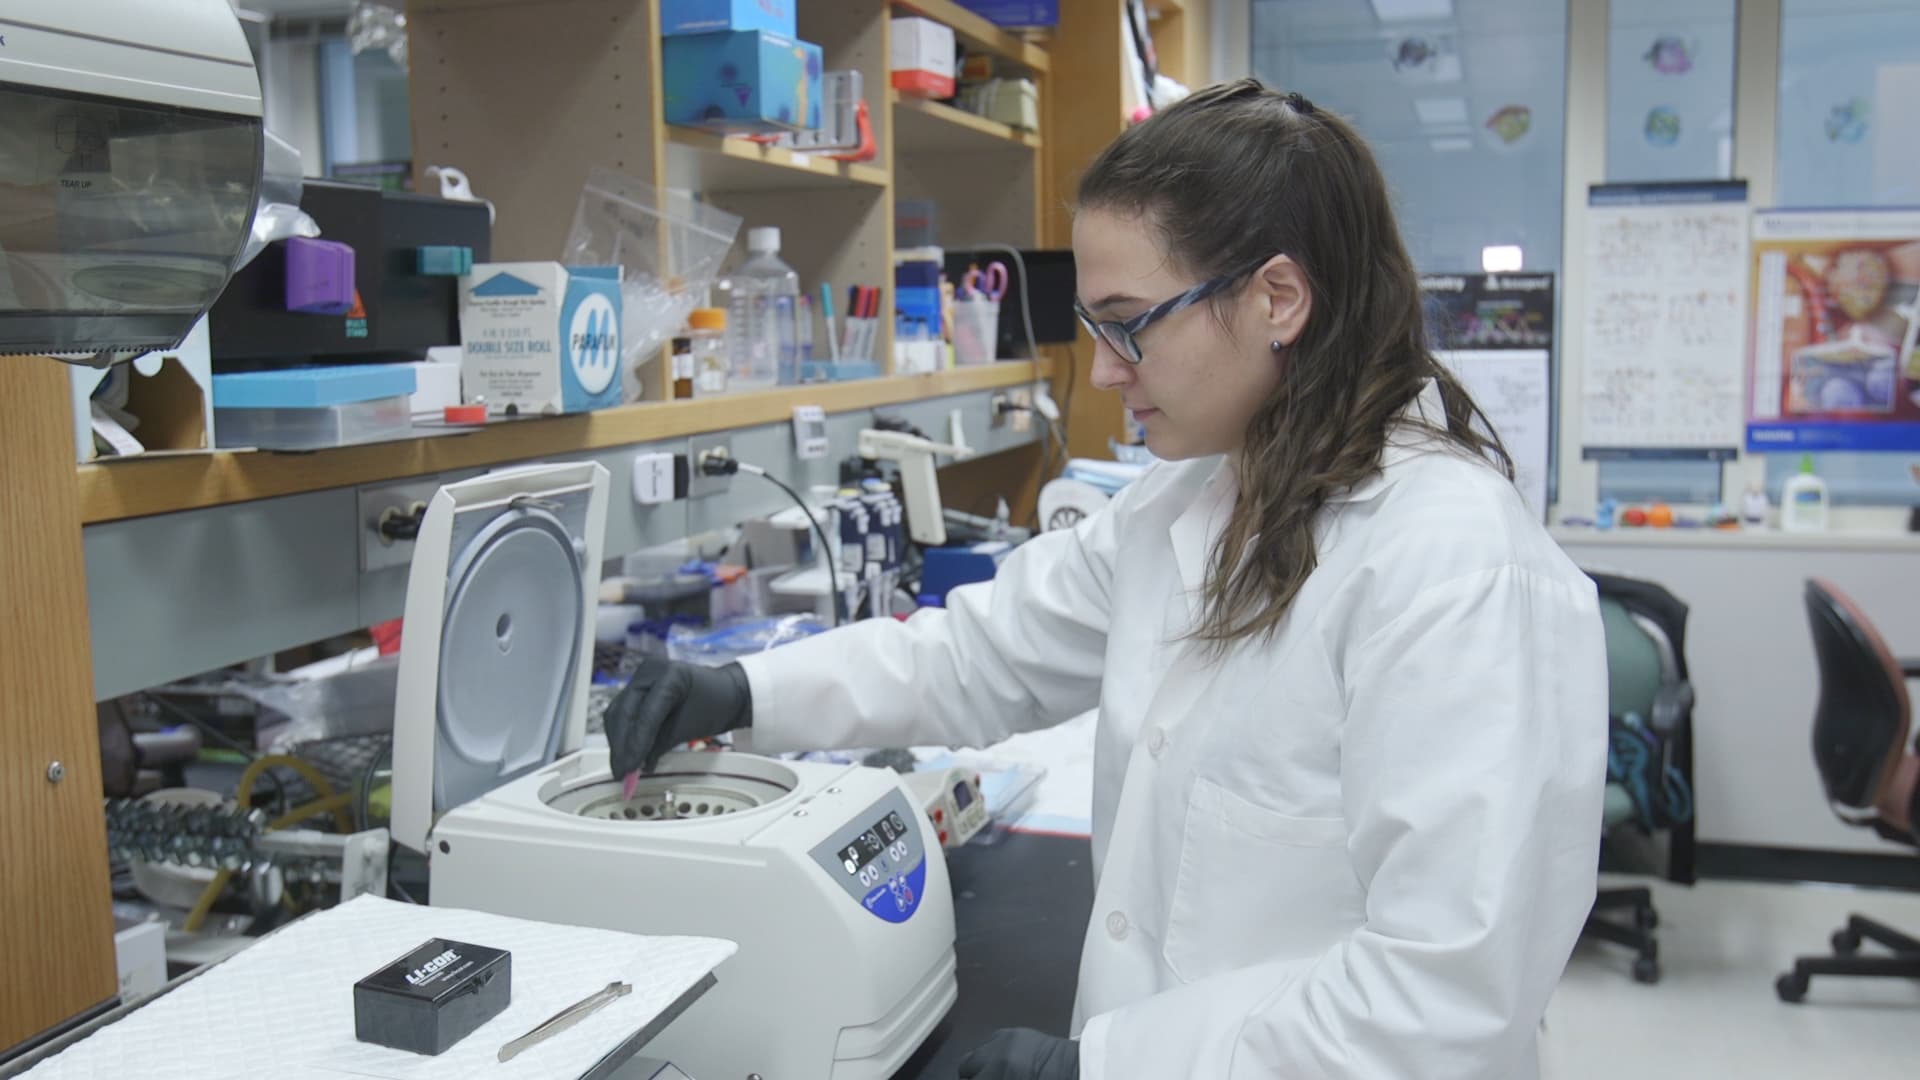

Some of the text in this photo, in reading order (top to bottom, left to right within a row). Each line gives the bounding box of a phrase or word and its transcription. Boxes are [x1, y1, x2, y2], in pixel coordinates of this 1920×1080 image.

[61, 180, 92, 189] TEAR UP
[467, 339, 552, 354] DOUBLE SIZE ROLL
